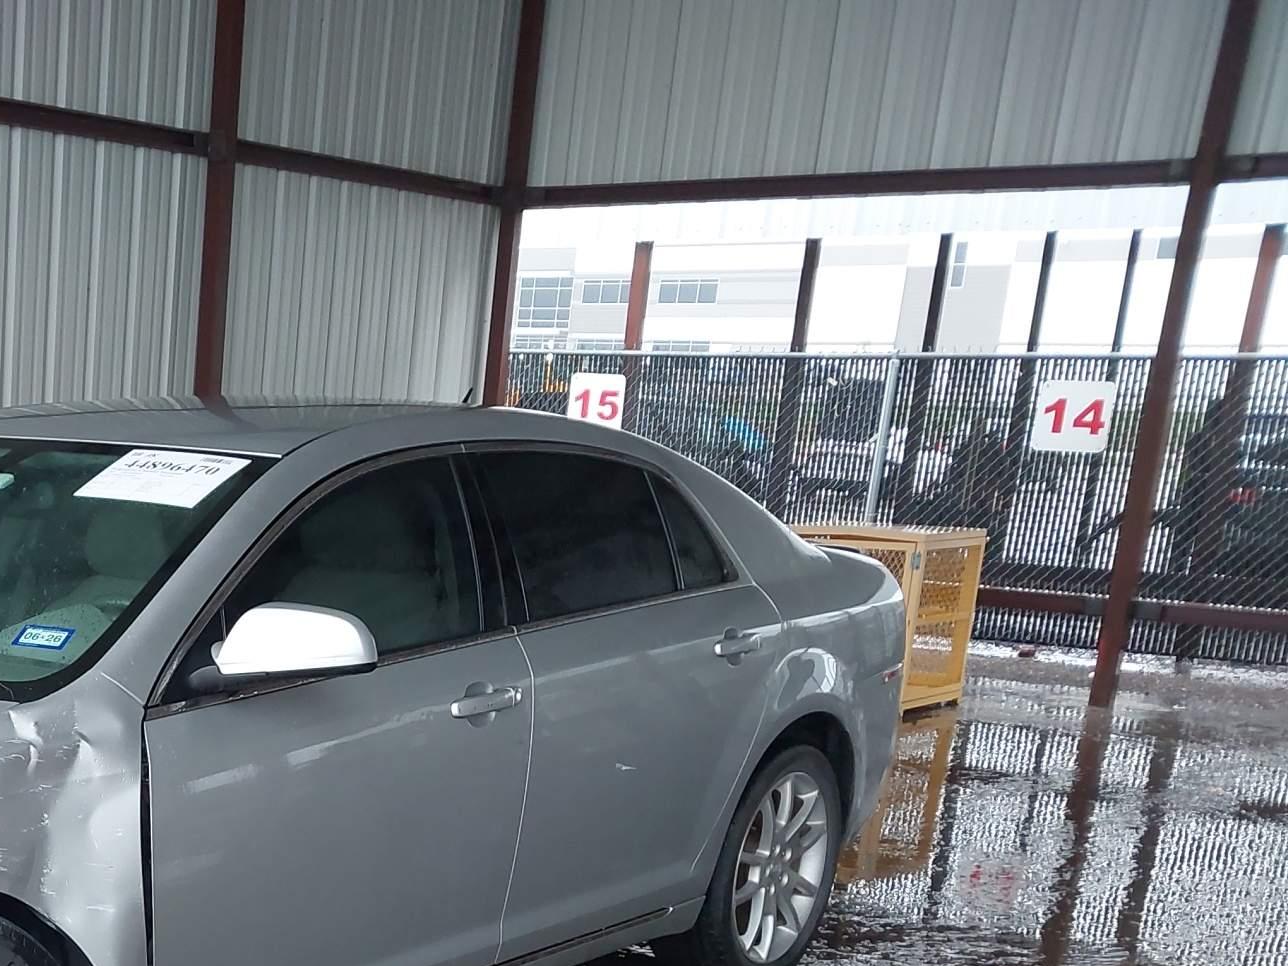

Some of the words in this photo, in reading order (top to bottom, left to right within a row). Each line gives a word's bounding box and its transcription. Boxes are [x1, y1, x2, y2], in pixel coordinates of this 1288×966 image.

[575, 388, 620, 420] 15
[1044, 398, 1105, 435] 14
[124, 459, 221, 477] 44896470
